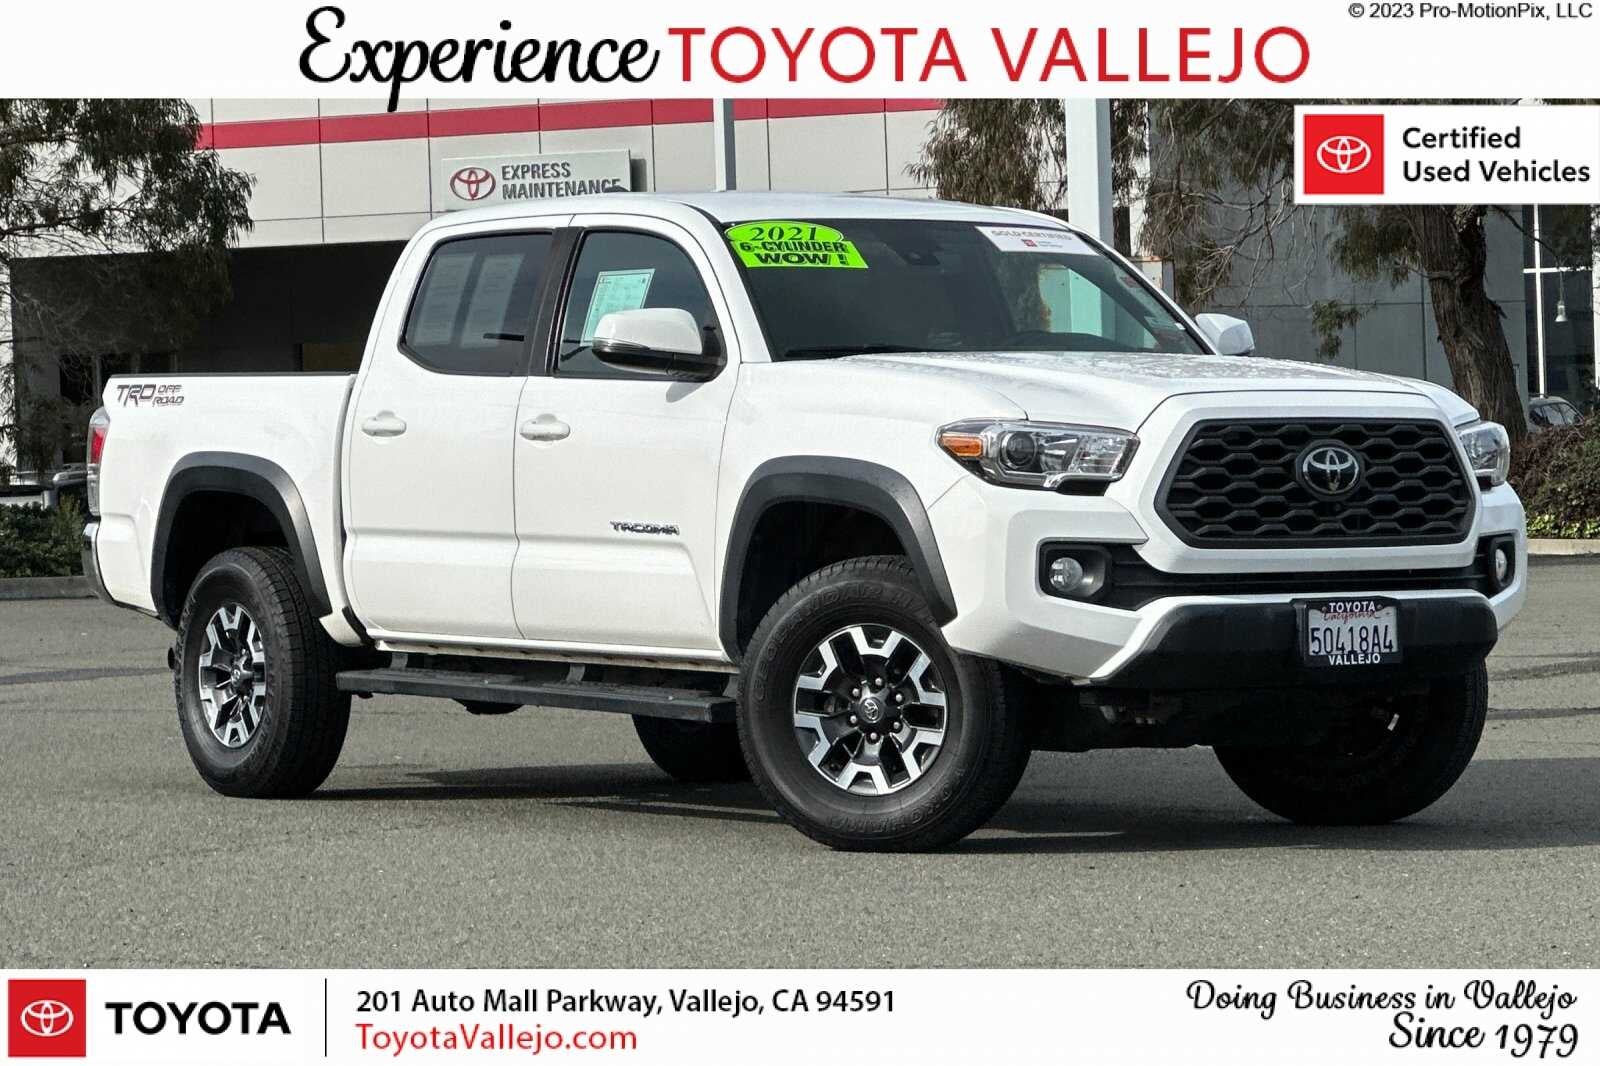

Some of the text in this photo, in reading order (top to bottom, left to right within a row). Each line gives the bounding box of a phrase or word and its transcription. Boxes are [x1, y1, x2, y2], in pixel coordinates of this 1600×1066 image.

[501, 162, 571, 181] EXPRESS
[751, 226, 817, 241] 2021
[739, 241, 848, 253] 6-CYLINDER
[116, 384, 183, 407] TRD OFF
[152, 396, 185, 408] ROAD
[609, 521, 680, 536] TACOMA
[1329, 601, 1376, 613] TOYOTA
[1310, 624, 1394, 656] 50418A4
[1328, 653, 1381, 666] VALLEJO
